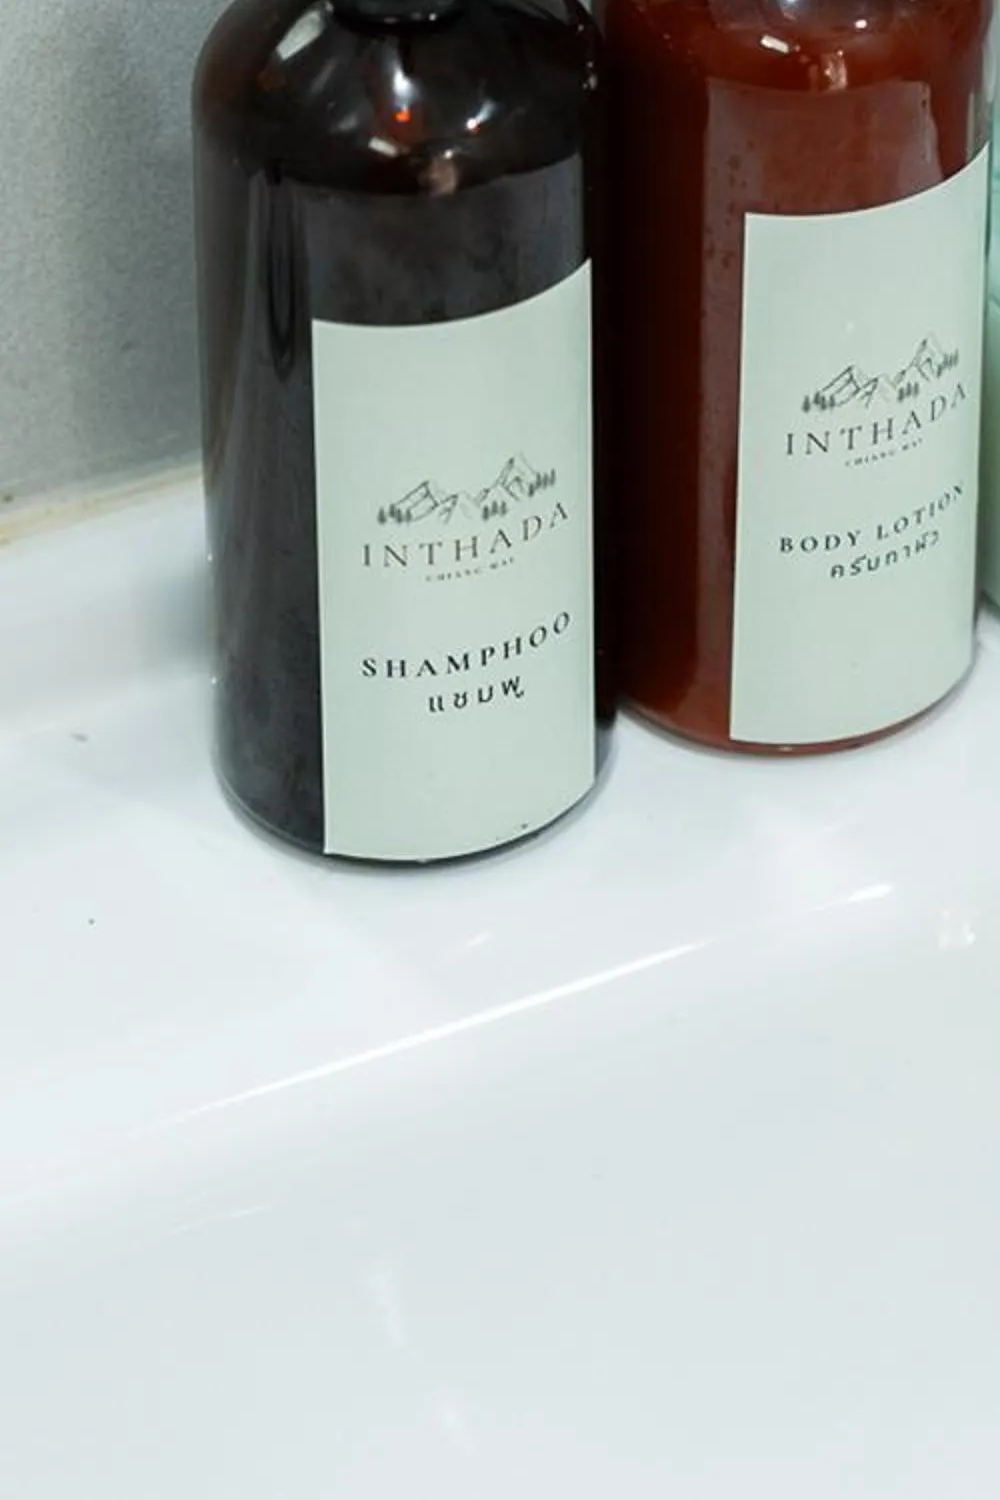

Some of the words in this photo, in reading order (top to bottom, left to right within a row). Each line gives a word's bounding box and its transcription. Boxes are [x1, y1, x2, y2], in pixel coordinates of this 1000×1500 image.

[786, 382, 967, 455] INTHADA
[360, 501, 569, 568] INTHADA
[779, 528, 861, 554] BODY
[876, 482, 964, 541] LOTION
[361, 611, 571, 678] SHAMPHOO
[428, 675, 525, 713] แชมพู
